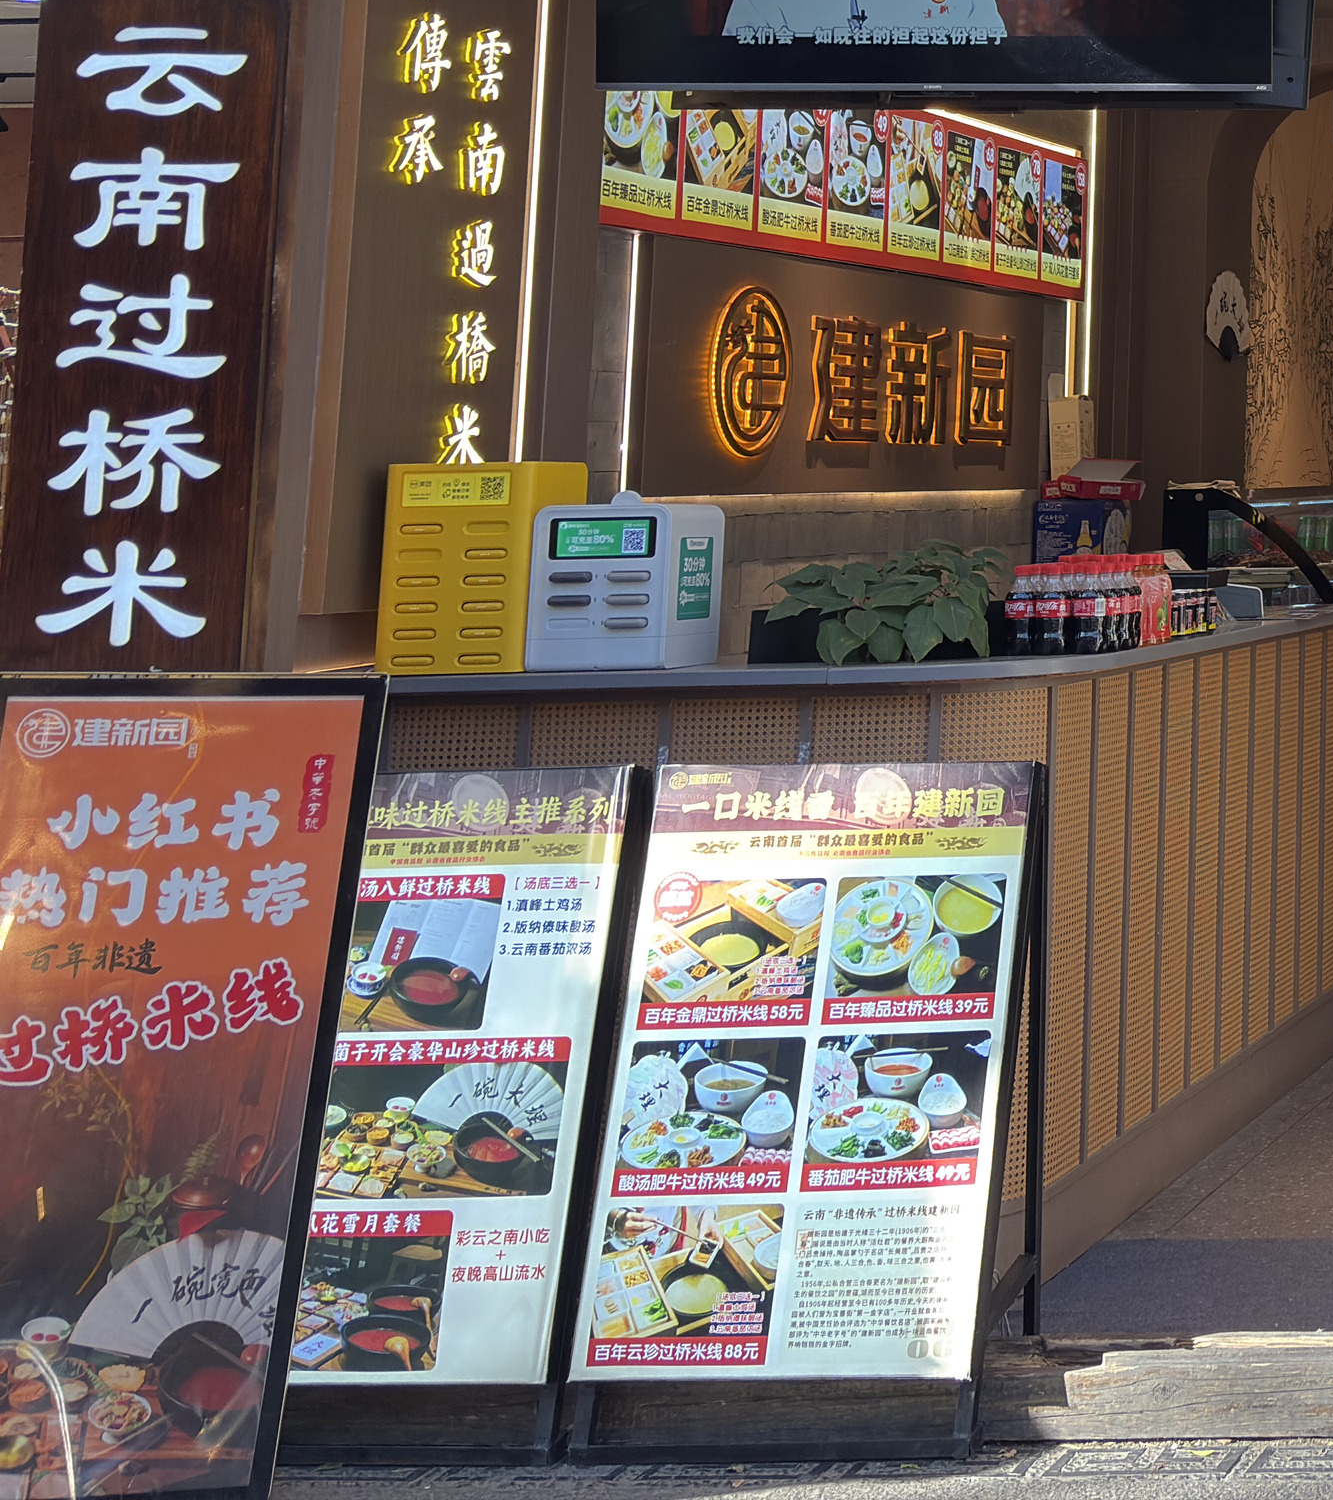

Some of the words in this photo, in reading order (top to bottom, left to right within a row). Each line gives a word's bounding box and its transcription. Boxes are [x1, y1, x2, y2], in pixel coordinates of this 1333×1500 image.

[736, 25, 1008, 45] 我们会一如既往的担起这份担子
[602, 178, 673, 212] 百年臻品过桥米线
[686, 195, 749, 223] 百年金鼎过桥米线
[762, 208, 818, 235] 酸汤肥牛过桥米线
[830, 221, 881, 245] 番茄肥牛过桥米线
[438, 29, 511, 464] 雲南過橋米
[35, 26, 248, 647] 云南过桥米
[806, 314, 1016, 446] 建新园
[72, 717, 188, 747] 建新园
[46, 788, 280, 850] 小红书
[364, 843, 395, 857] 首届
[749, 834, 802, 849] 云南首届
[0, 860, 310, 927] 热门推荐
[360, 877, 491, 897] 汤八鲜过桥米线
[502, 920, 596, 934] 2.版纳傣味酸汤
[22, 938, 163, 979] 百年非遗
[498, 942, 592, 956] 3.云南番茄浓汤
[644, 1002, 804, 1025] 百年金鼎过桥米线58元
[829, 998, 989, 1020] 百年臻品过桥米线39元
[334, 1038, 555, 1062] 菌子开会豪华山珍过桥米线
[617, 1171, 782, 1193] 酸汤肥牛过桥米线49元
[807, 1163, 972, 1186] 番茄肥牛过桥米线49元
[455, 1228, 551, 1247] 彩云之南小吃
[451, 1264, 546, 1283] 夜晚高山流水
[594, 1340, 759, 1362] 百年云珍过桥米线88元
